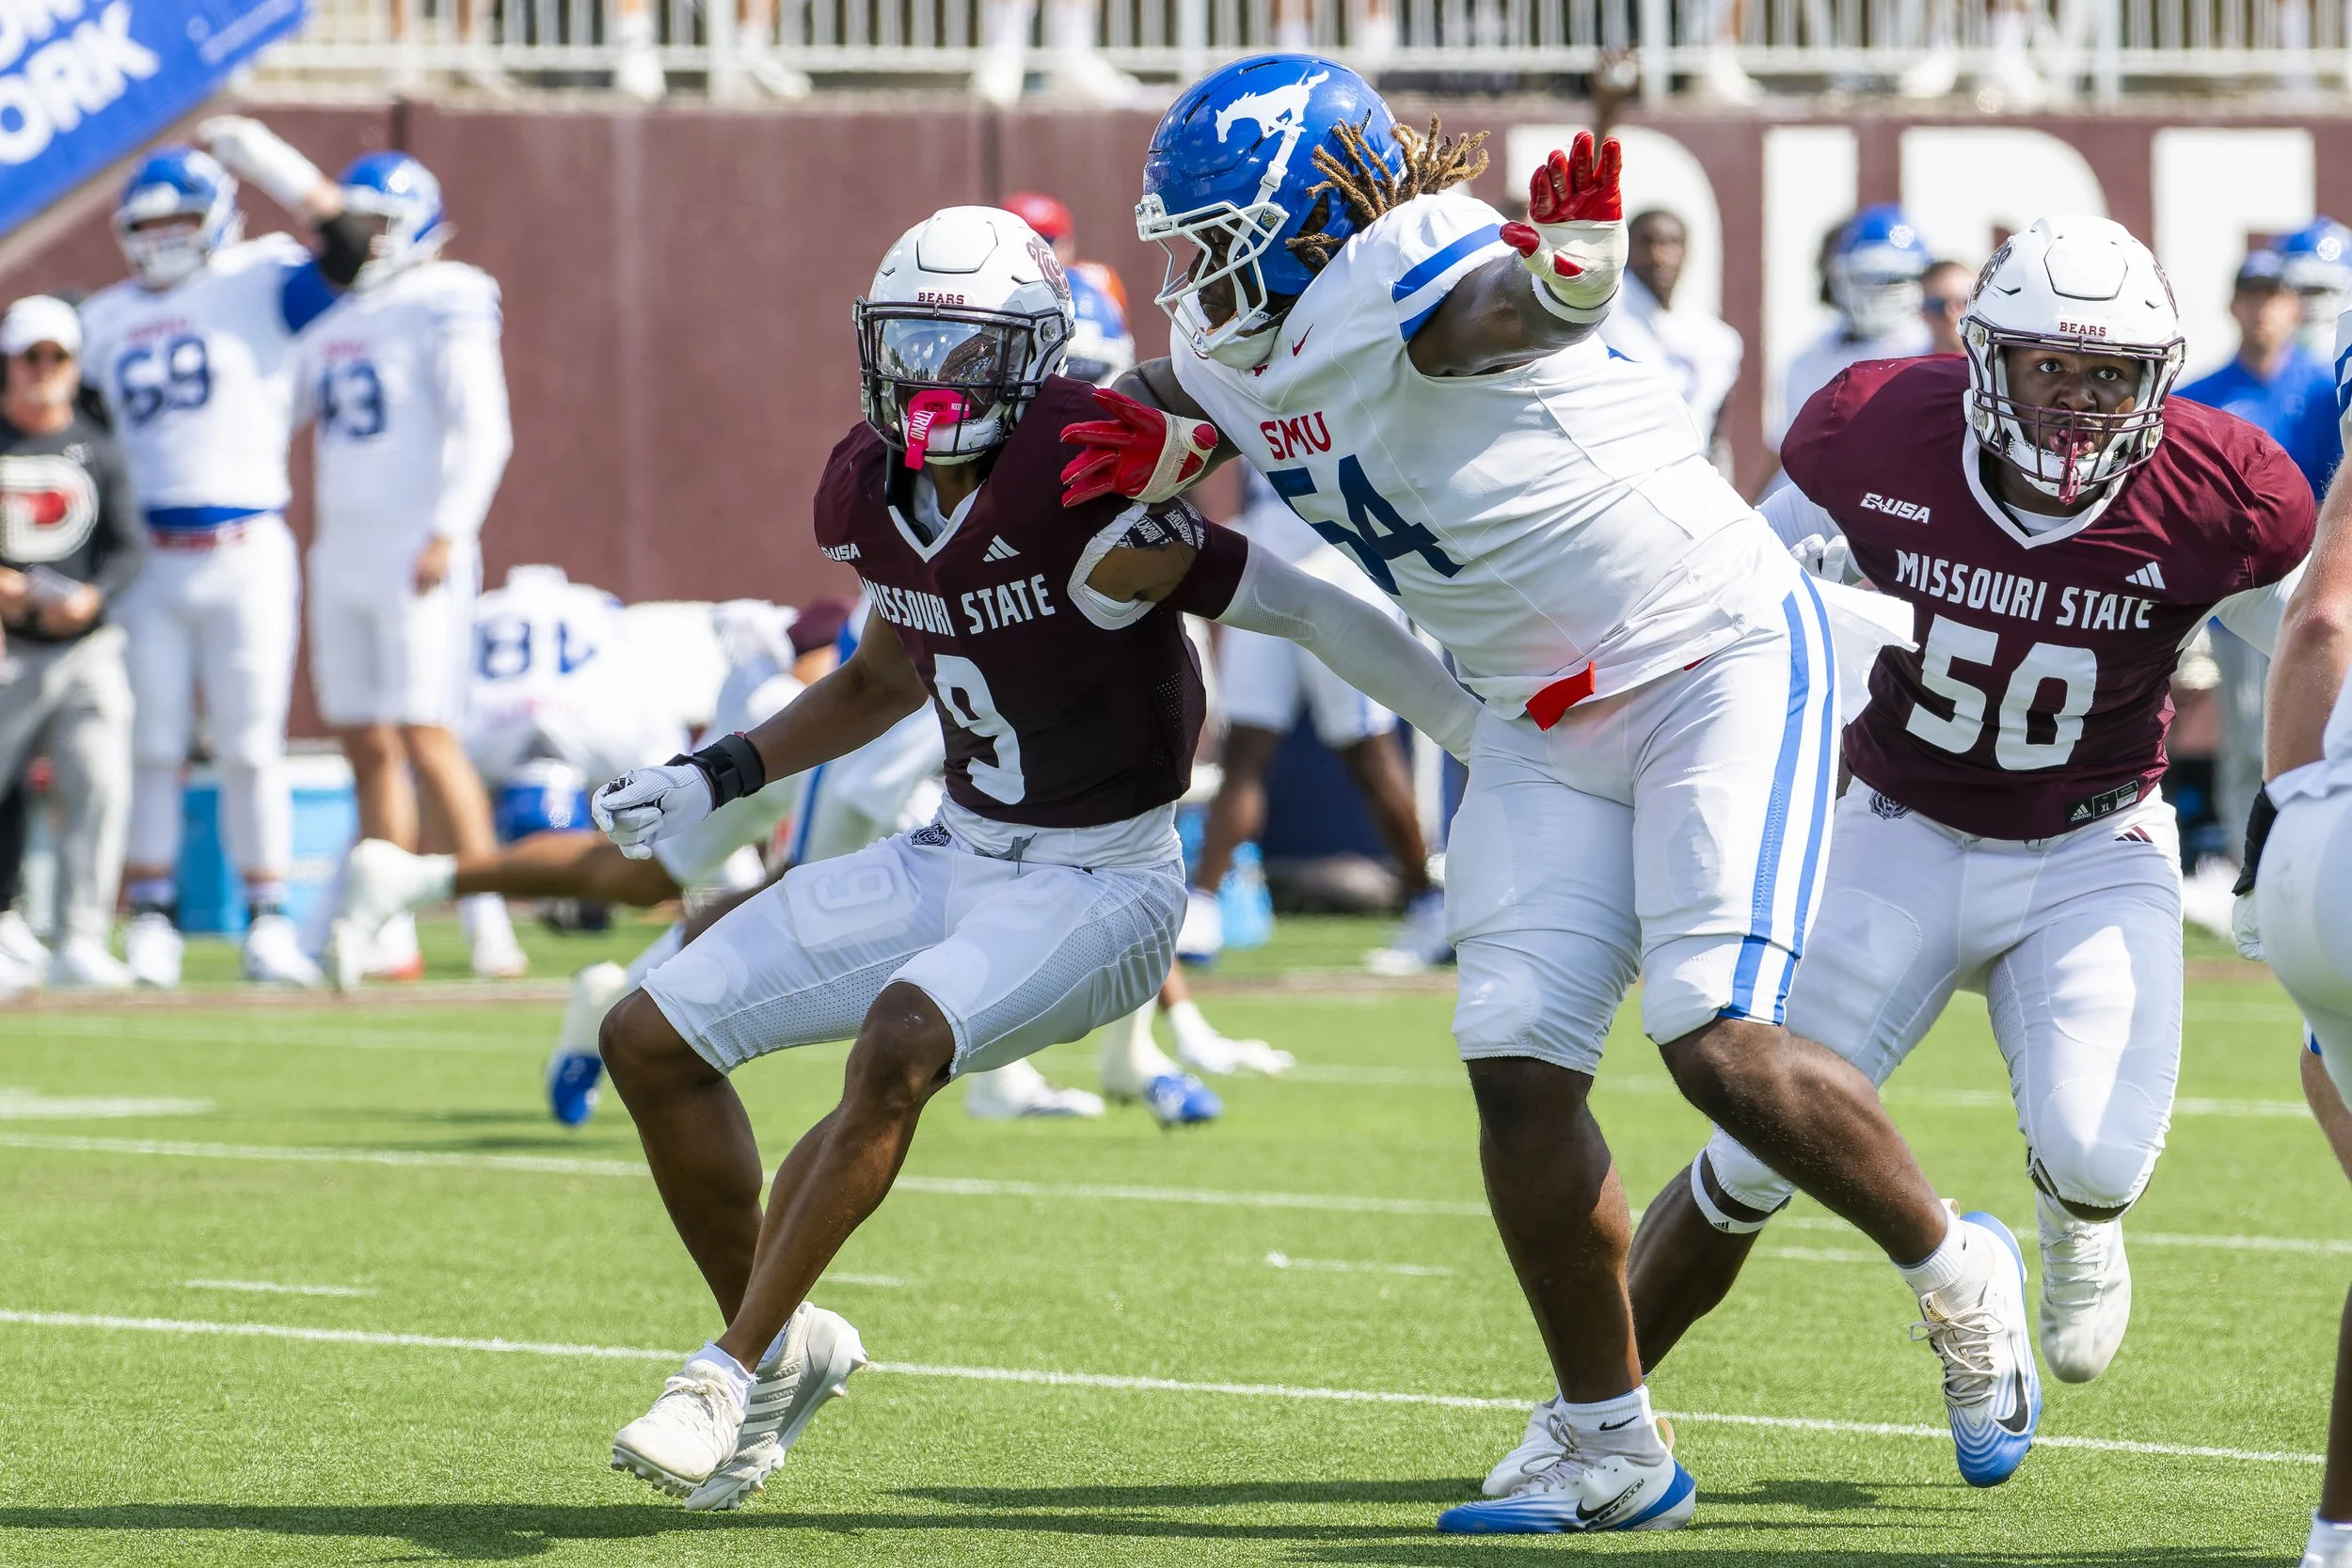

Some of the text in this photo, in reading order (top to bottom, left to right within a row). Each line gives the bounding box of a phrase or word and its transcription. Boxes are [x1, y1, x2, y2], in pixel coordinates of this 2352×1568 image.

[917, 292, 965, 305] BEARS
[2058, 322, 2106, 337] BEARS
[114, 332, 211, 426] 69
[1260, 411, 1331, 461] SMU
[1265, 453, 1466, 596] 54
[863, 573, 1056, 638] MISSOURI STATE
[1896, 549, 2161, 631] MISSOURI STATE
[1905, 613, 2098, 771] 50
[933, 653, 1026, 805] 9
[2071, 812, 2091, 821] adidas
[2101, 802, 2110, 813] XL
[1620, 1478, 1645, 1505] ZOOM
